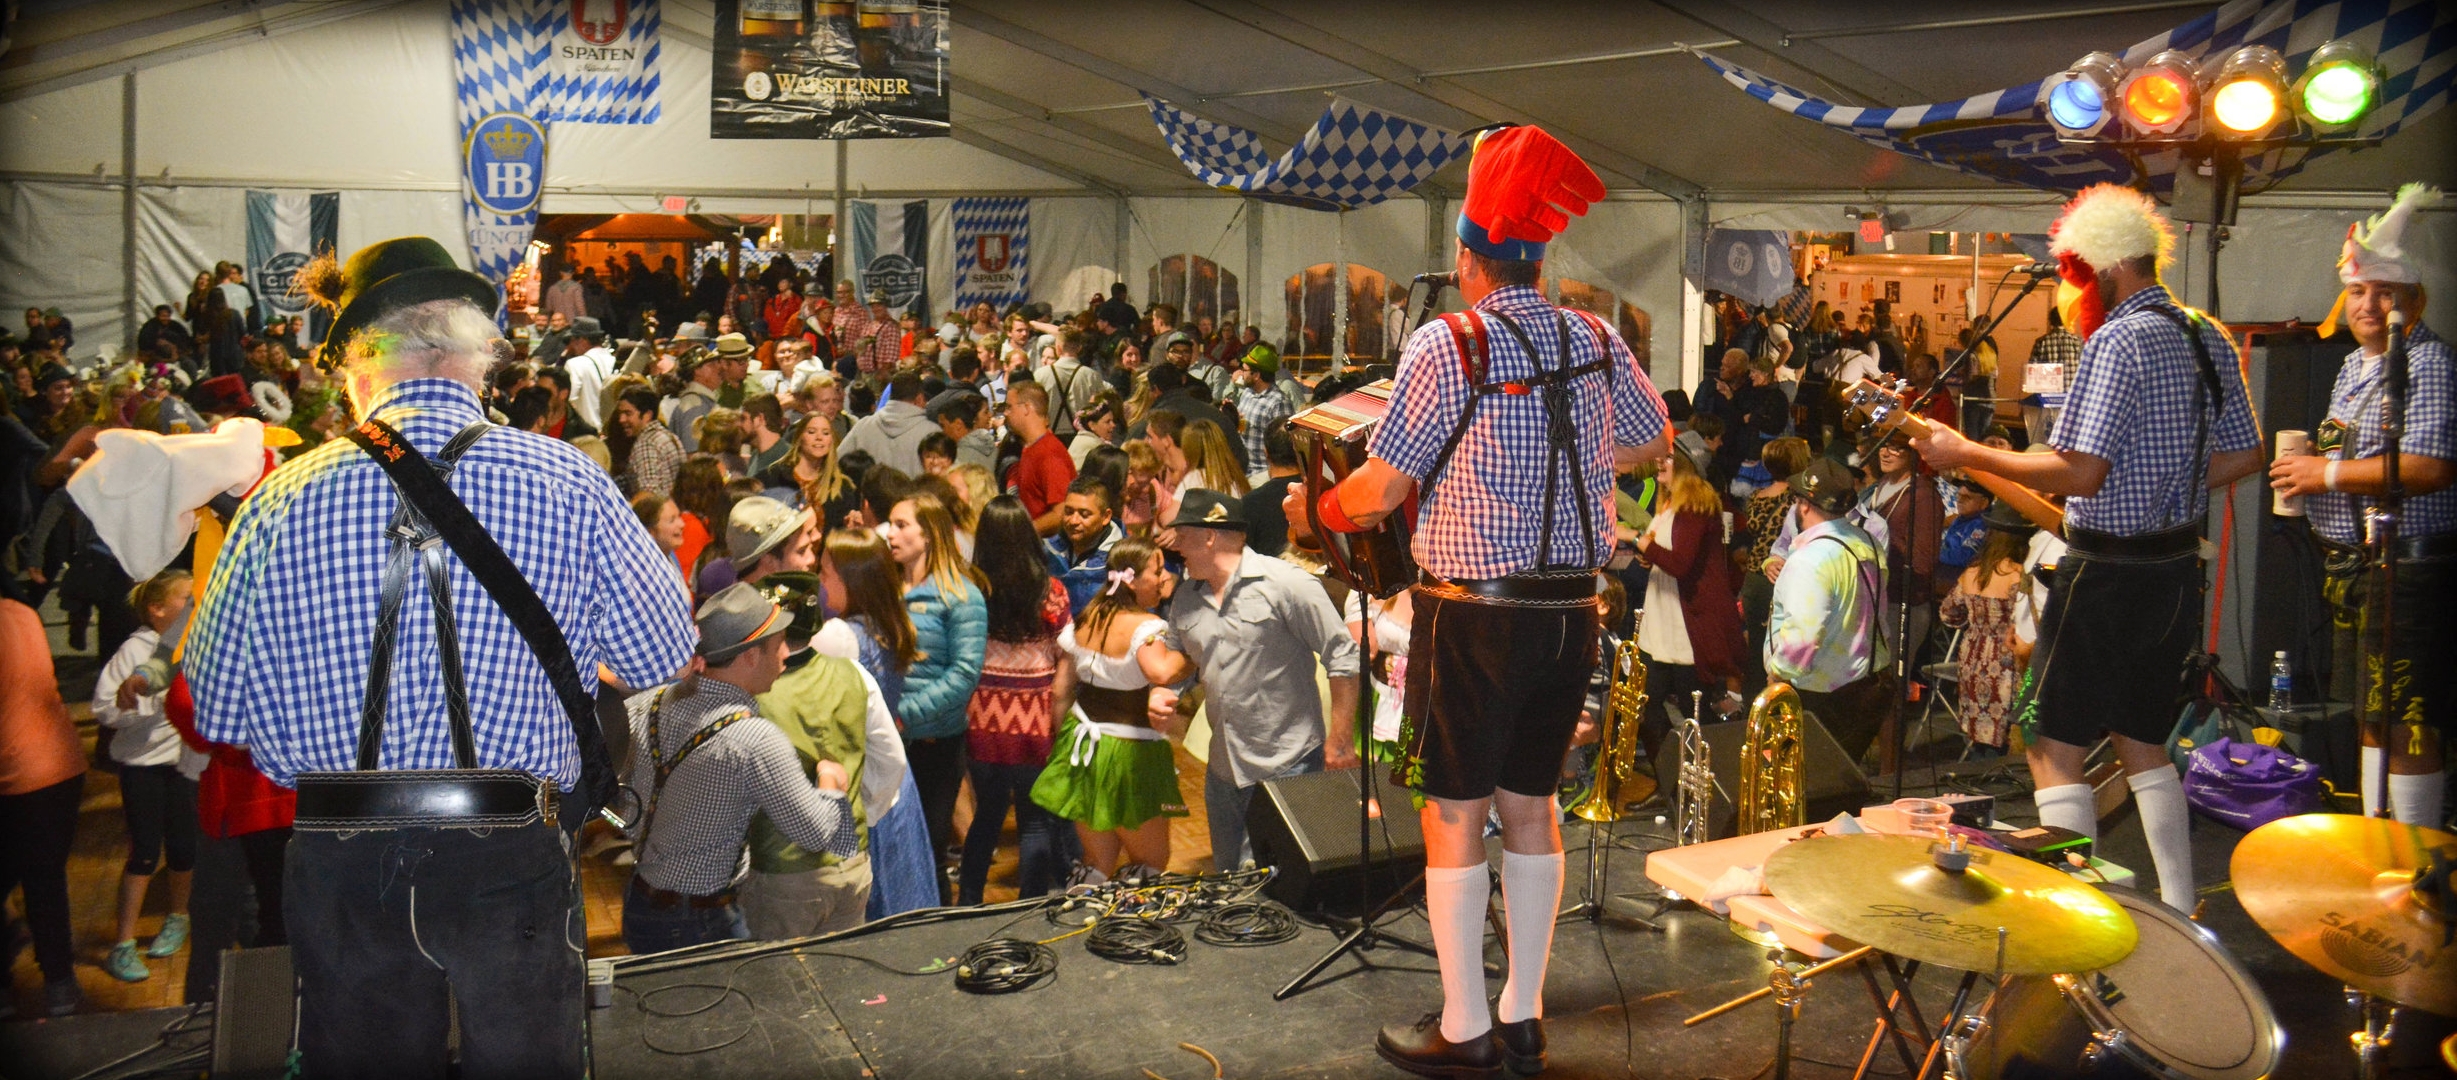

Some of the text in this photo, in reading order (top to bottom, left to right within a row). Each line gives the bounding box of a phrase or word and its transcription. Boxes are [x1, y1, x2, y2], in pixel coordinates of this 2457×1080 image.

[562, 46, 636, 60] SPATEN
[774, 73, 911, 95] WARSTEINER
[485, 162, 534, 198] HB
[865, 275, 919, 286] ICICLE
[2319, 911, 2436, 969] SABIAN
